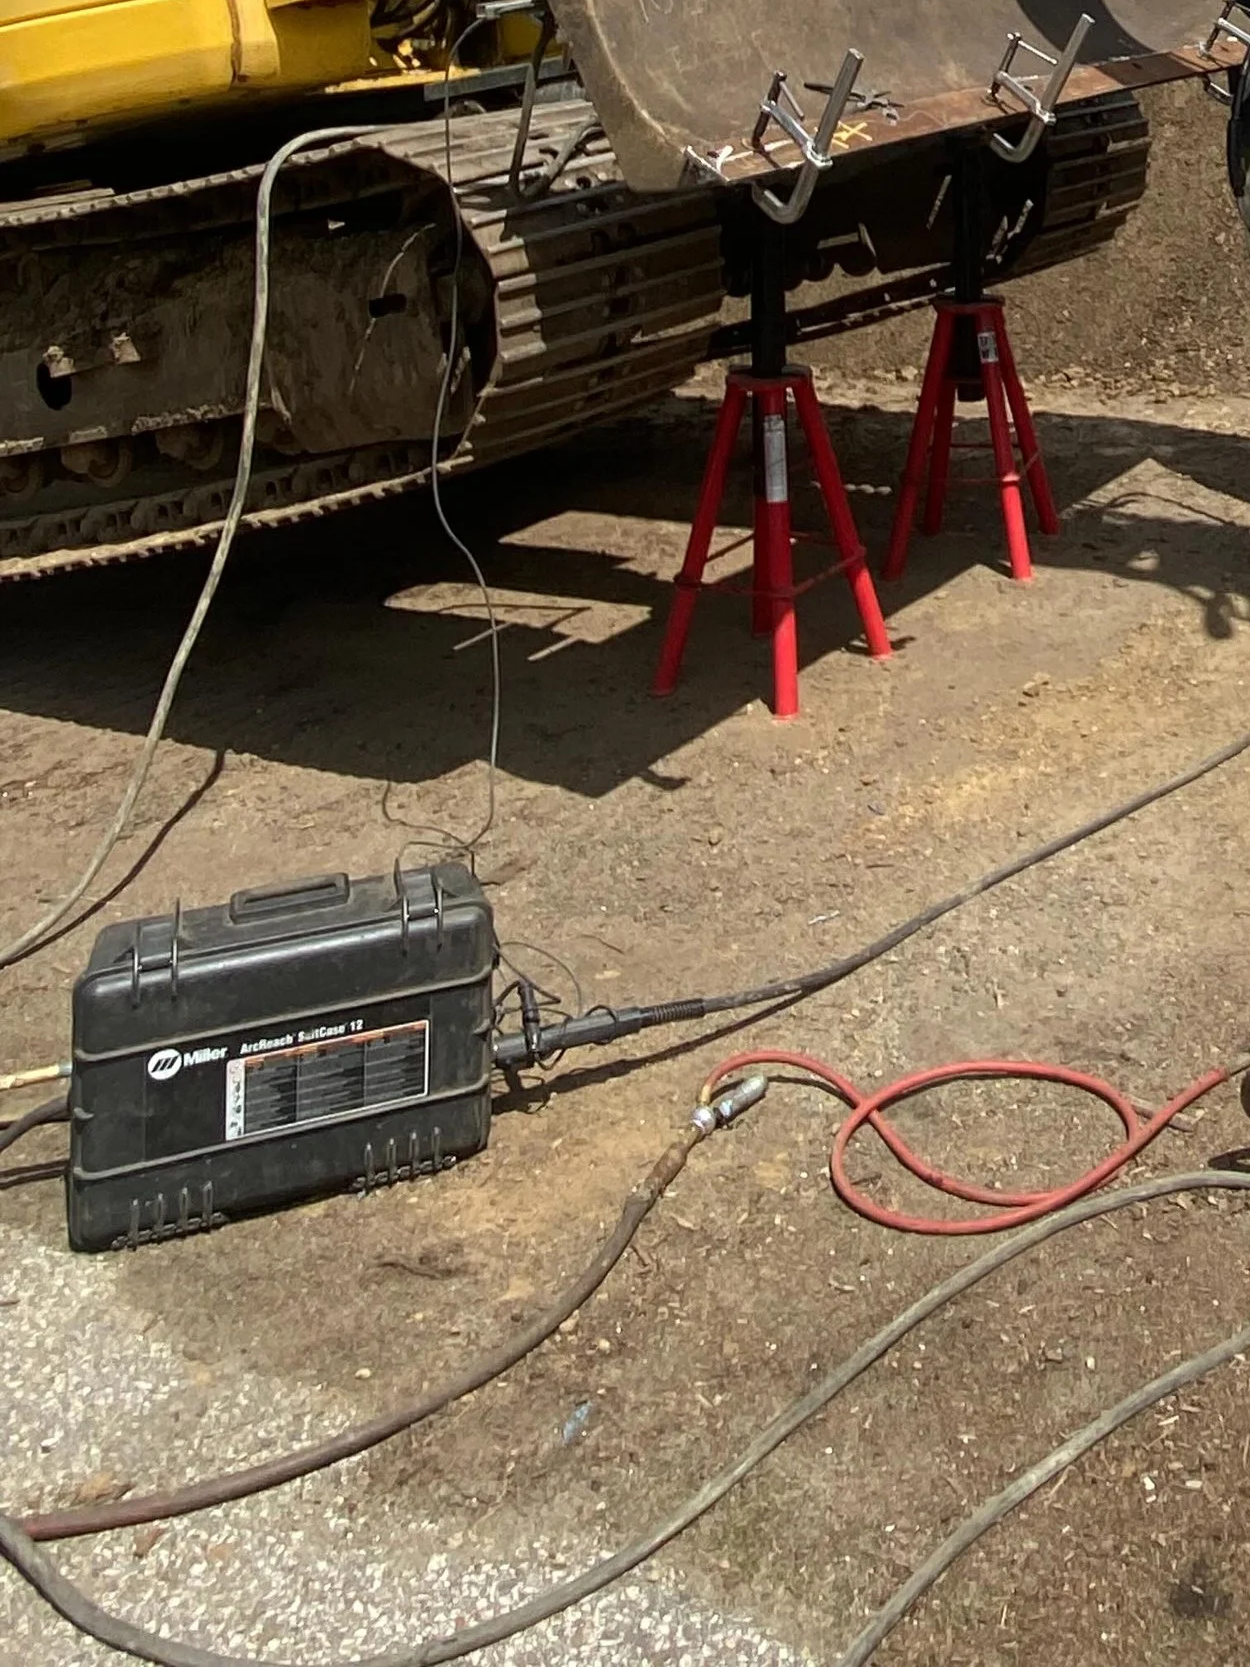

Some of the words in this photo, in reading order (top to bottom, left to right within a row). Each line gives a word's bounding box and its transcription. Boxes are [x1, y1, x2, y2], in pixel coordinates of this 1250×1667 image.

[240, 1035, 293, 1055] ArcReach
[298, 1025, 346, 1043] SuitCase
[350, 1019, 364, 1031] 12
[183, 1046, 228, 1067] Miller
